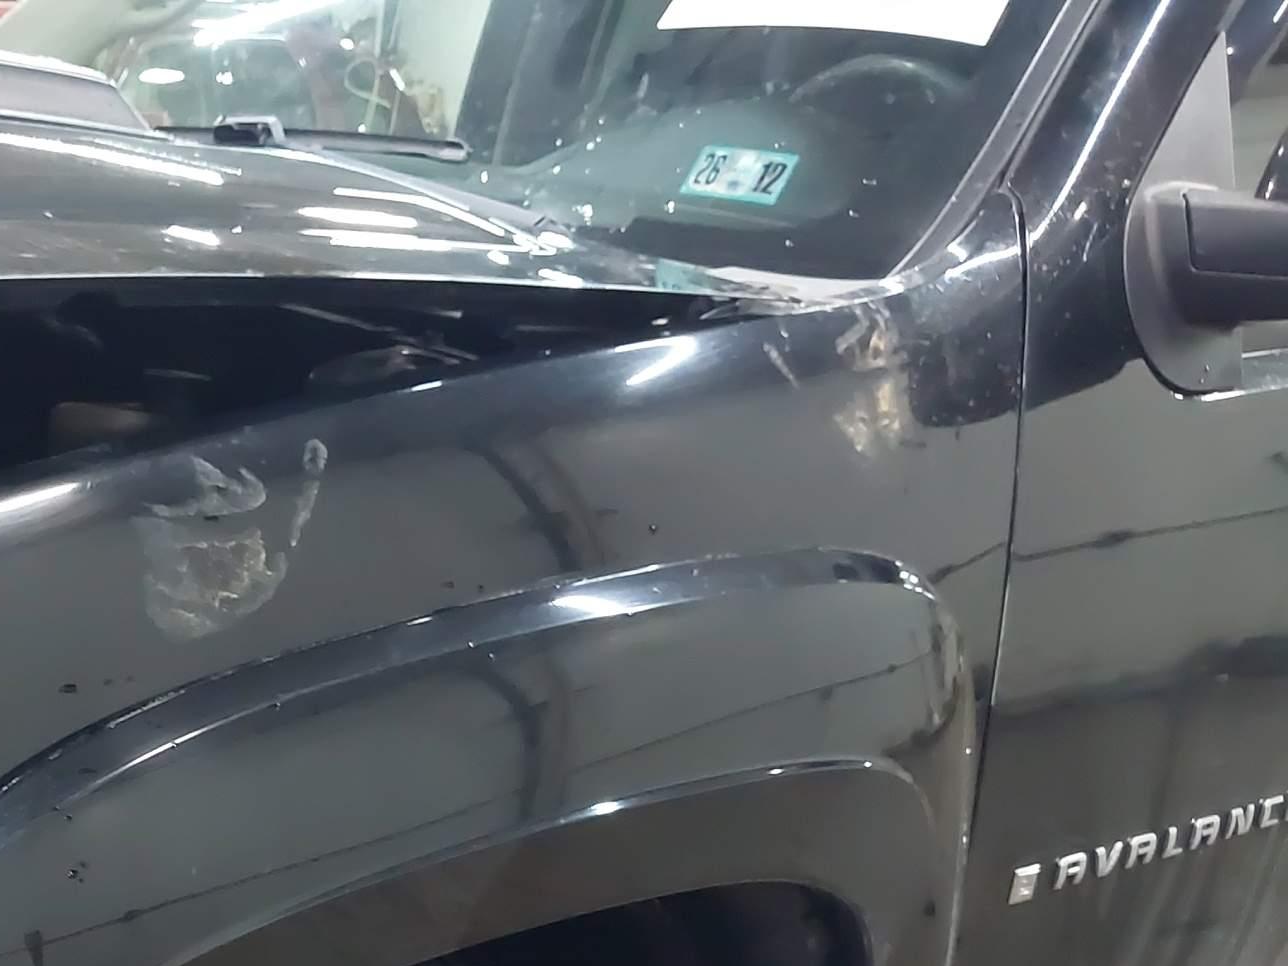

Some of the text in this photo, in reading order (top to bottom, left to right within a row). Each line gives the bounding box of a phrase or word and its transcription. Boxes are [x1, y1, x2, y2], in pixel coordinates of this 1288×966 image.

[693, 152, 788, 196] 26 12
[1053, 791, 1288, 891] AVALANC
